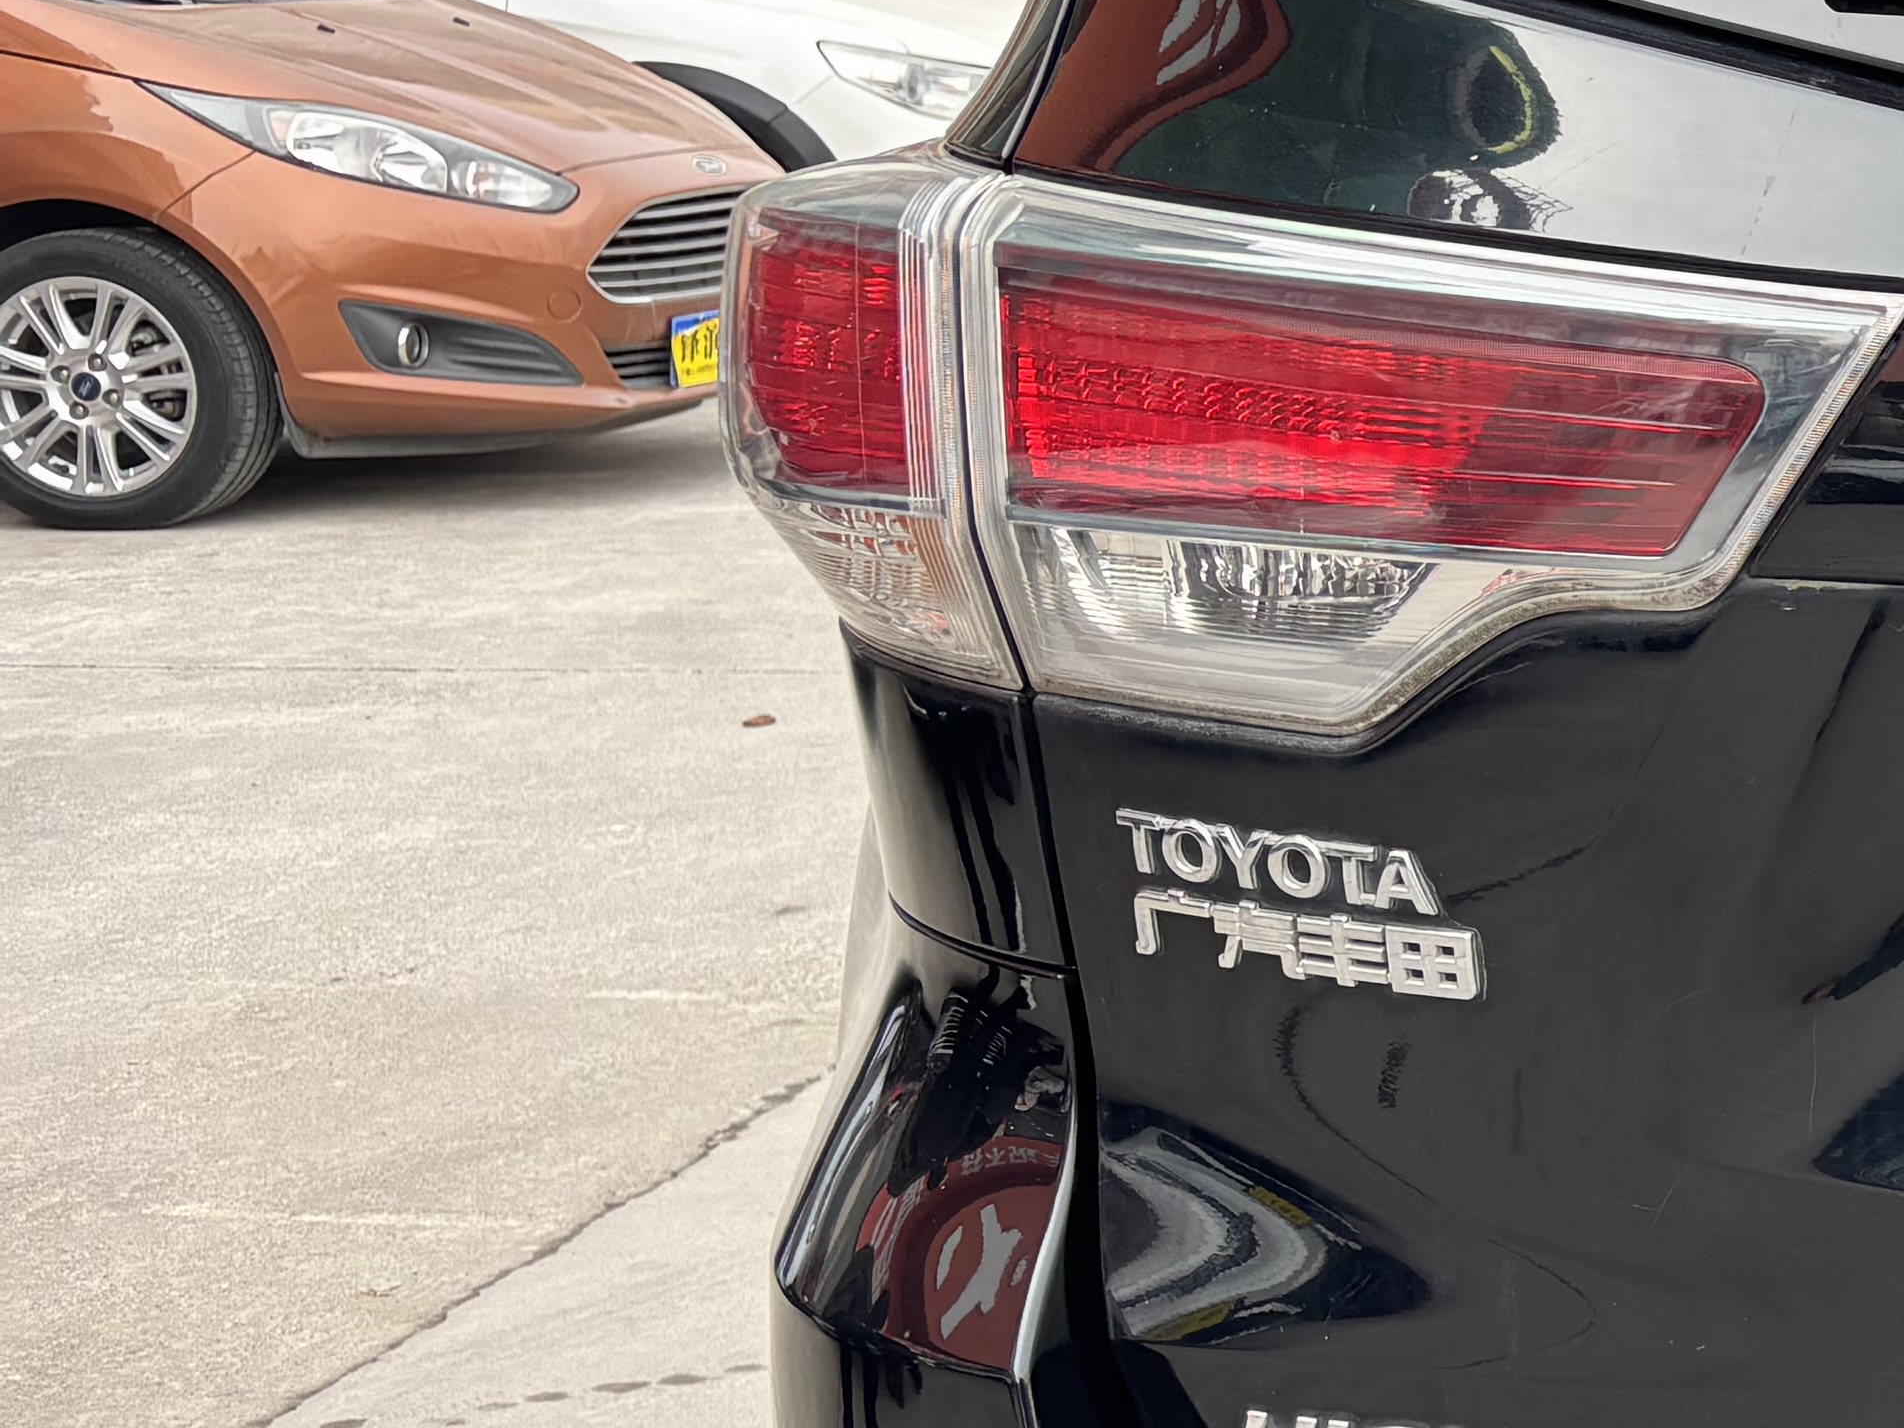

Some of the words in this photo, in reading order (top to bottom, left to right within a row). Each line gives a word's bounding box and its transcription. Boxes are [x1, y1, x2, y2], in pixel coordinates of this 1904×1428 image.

[1115, 807, 1440, 916] TOYOTA
[1133, 888, 1485, 1001] 广汽丰田
